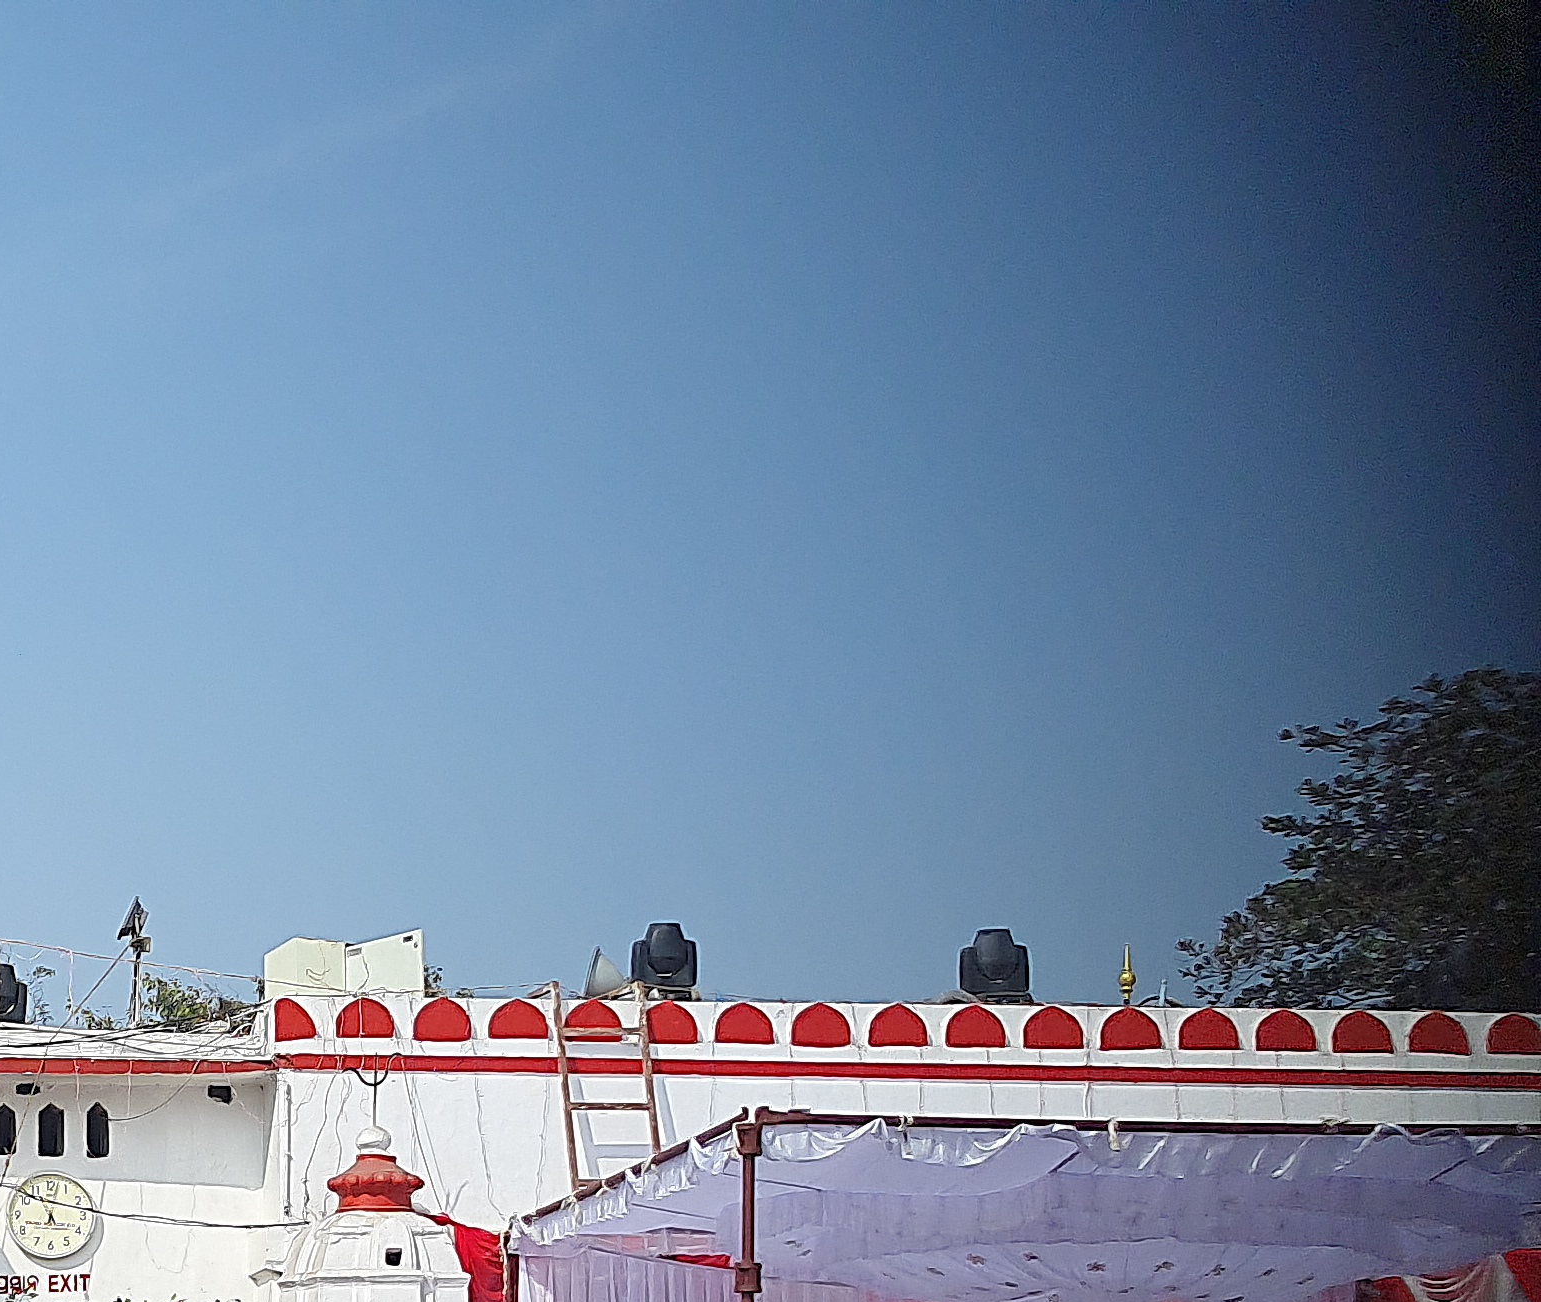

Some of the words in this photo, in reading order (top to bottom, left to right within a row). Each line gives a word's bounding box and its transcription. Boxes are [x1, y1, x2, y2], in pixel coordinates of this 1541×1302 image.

[31, 1184, 40, 1195] 11
[46, 1180, 56, 1191] 12
[63, 1183, 68, 1195] 1
[18, 1194, 31, 1206] 10
[74, 1195, 82, 1206] 2
[14, 1209, 22, 1221] 9
[79, 1210, 87, 1221] 3
[19, 1224, 26, 1236] 8
[74, 1224, 82, 1236] 4
[32, 1236, 41, 1247] 7
[47, 1240, 55, 1251] 6
[63, 1235, 70, 1247] 5
[48, 1273, 91, 1293] EXIT
